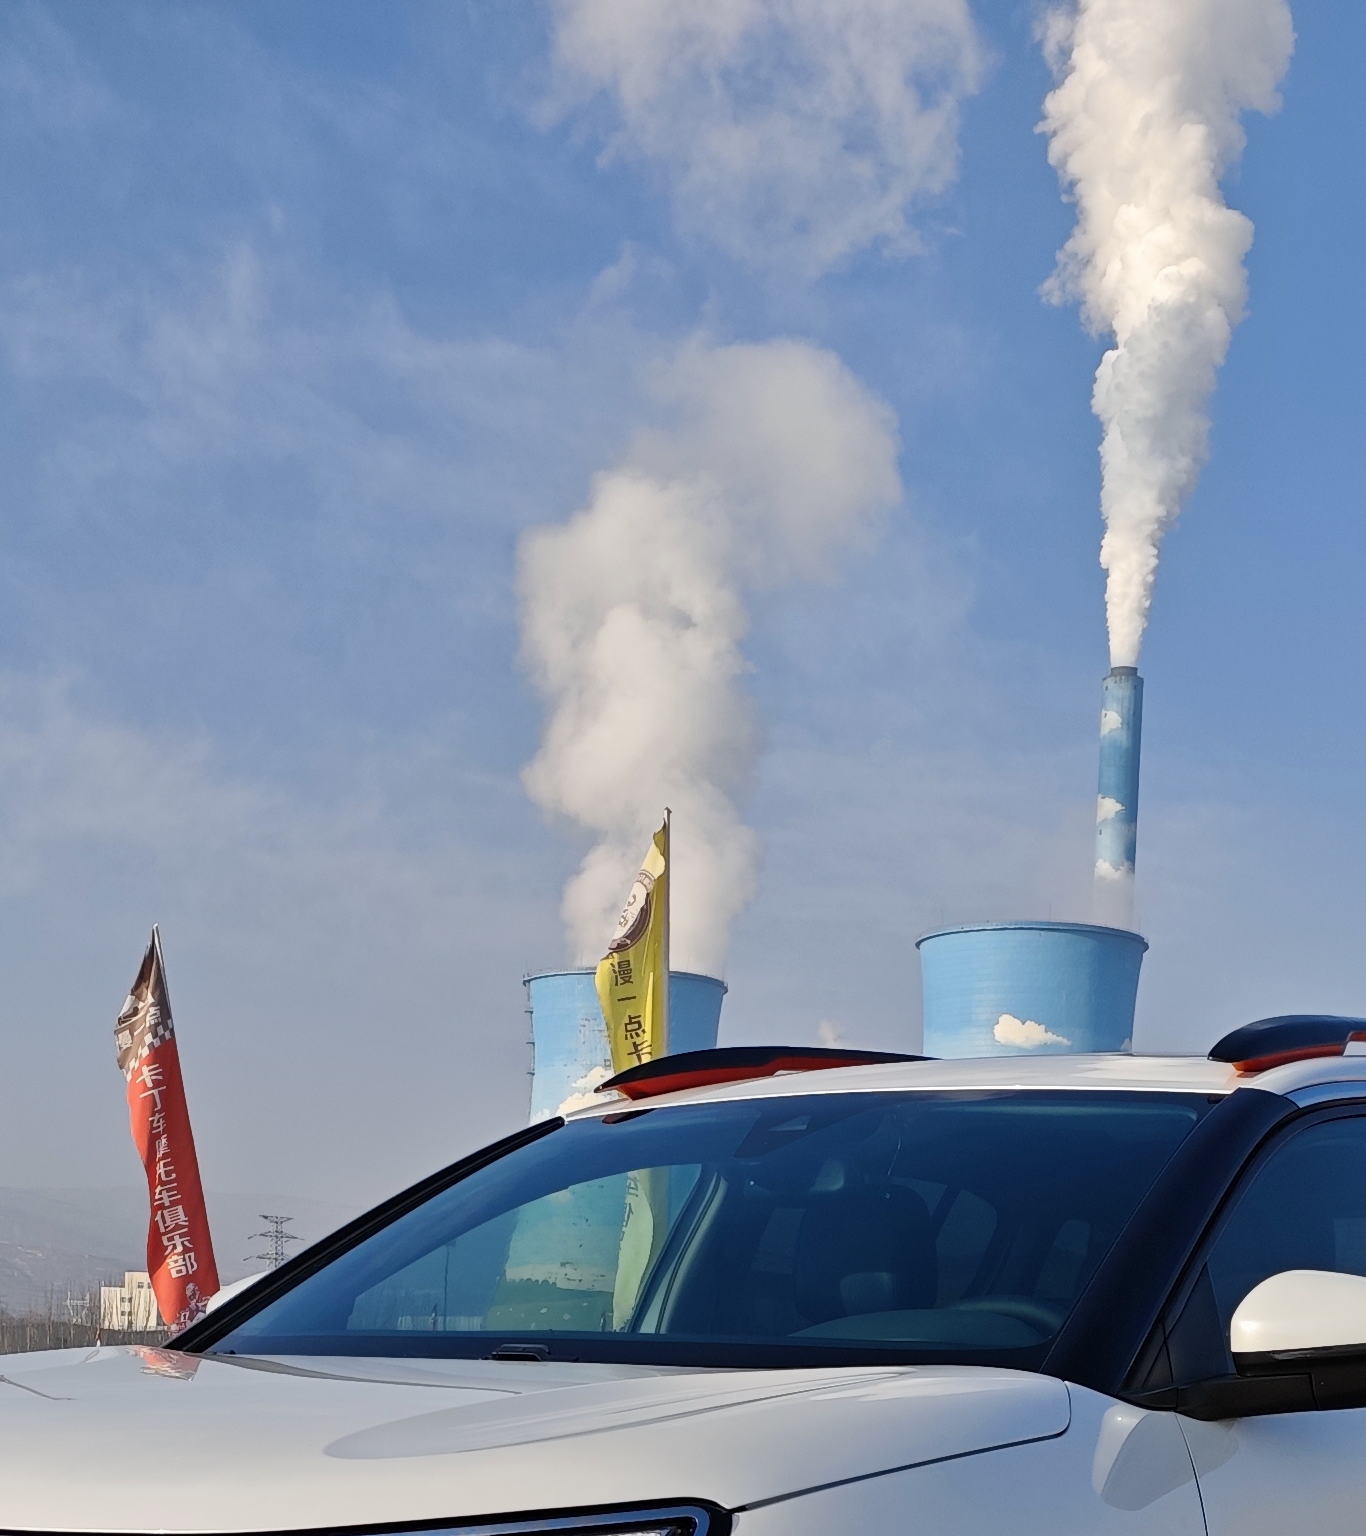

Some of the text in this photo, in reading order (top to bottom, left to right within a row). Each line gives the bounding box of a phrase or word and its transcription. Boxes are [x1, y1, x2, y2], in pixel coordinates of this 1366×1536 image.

[610, 960, 652, 1064] 漫一点卡
[136, 1063, 198, 1279] 卡丁车摩托车俱乐部
